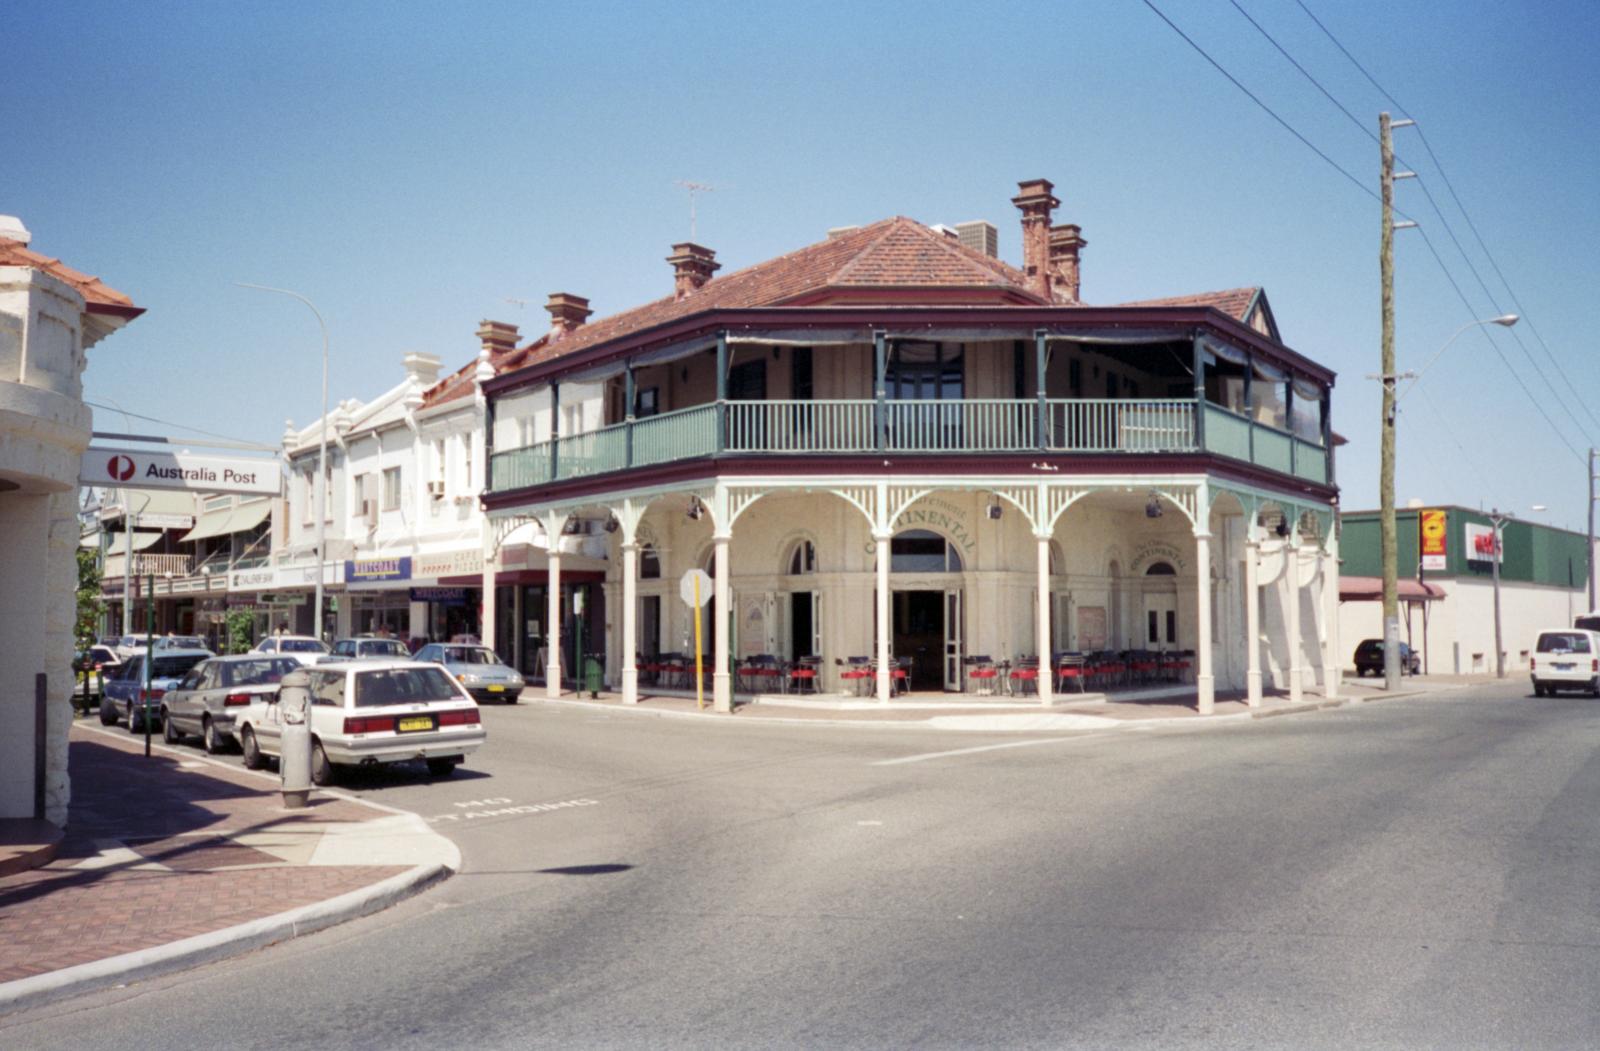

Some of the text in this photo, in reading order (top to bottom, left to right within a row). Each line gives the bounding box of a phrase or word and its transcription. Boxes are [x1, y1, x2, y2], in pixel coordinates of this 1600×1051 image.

[145, 463, 257, 485] Australia Post
[453, 797, 512, 808] NO
